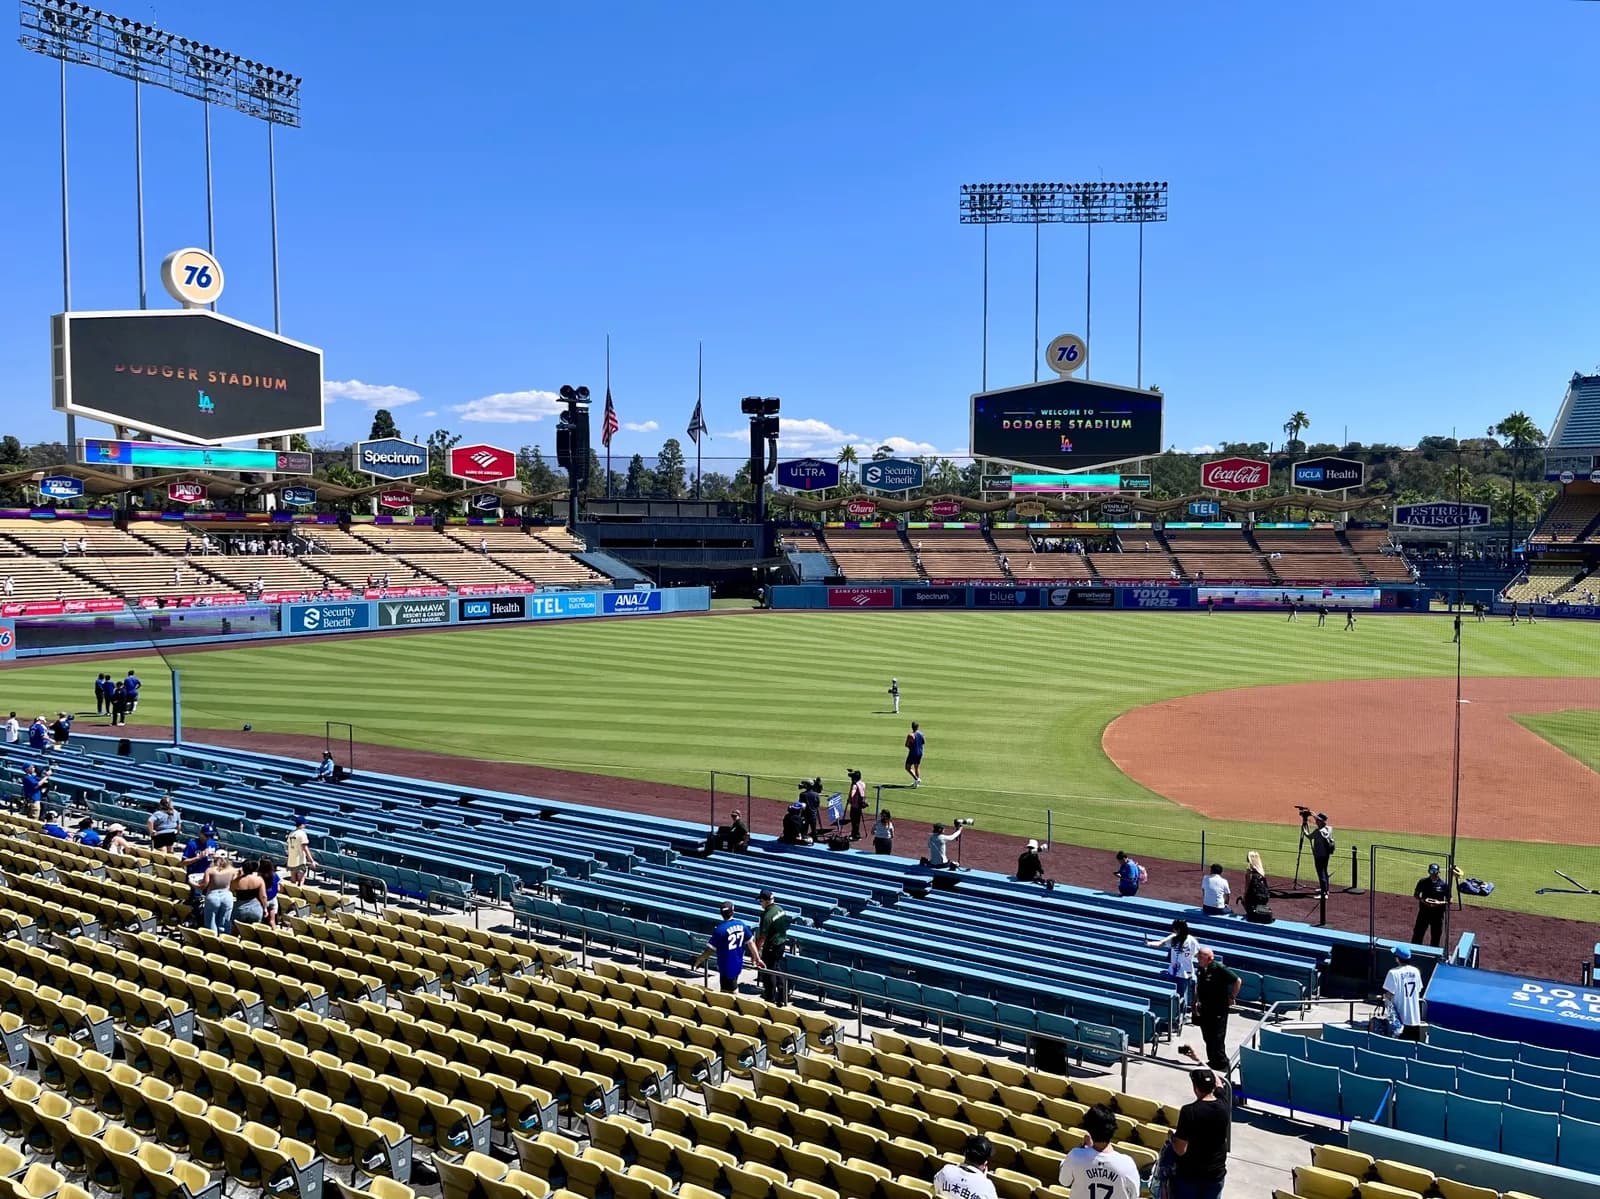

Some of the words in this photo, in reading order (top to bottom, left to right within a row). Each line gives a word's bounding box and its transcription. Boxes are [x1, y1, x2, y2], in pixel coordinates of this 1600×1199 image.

[184, 265, 212, 288] 76
[1057, 345, 1078, 362] 76
[208, 371, 288, 391] STADIUM
[1003, 419, 1062, 430] DODGER
[1069, 419, 1132, 430] STADIUM
[364, 450, 420, 465] Spectrum
[790, 468, 826, 477] ULTRA
[884, 466, 918, 477] Security
[1208, 465, 1264, 484] Coca-Cola
[1298, 471, 1321, 479] UCLA
[1326, 469, 1358, 479] Health
[885, 475, 914, 484] Benefit
[175, 485, 201, 497] JINRO
[1193, 503, 1215, 513] TEL
[1403, 516, 1464, 525] JALISCO
[916, 592, 950, 601] Spectrum
[989, 591, 1015, 601] blue
[1132, 589, 1170, 599] TOYO
[615, 595, 637, 606] ANA
[1138, 598, 1178, 607] TIRES
[322, 606, 356, 618] Security
[467, 605, 487, 614] UCLA
[492, 602, 520, 614] Health
[534, 598, 564, 615] TEL
[323, 617, 351, 628] Benefit
[728, 932, 744, 950] 27
[1404, 981, 1415, 997] 17
[1086, 1168, 1119, 1182] OHTANI
[1088, 1183, 1114, 1199] 17
